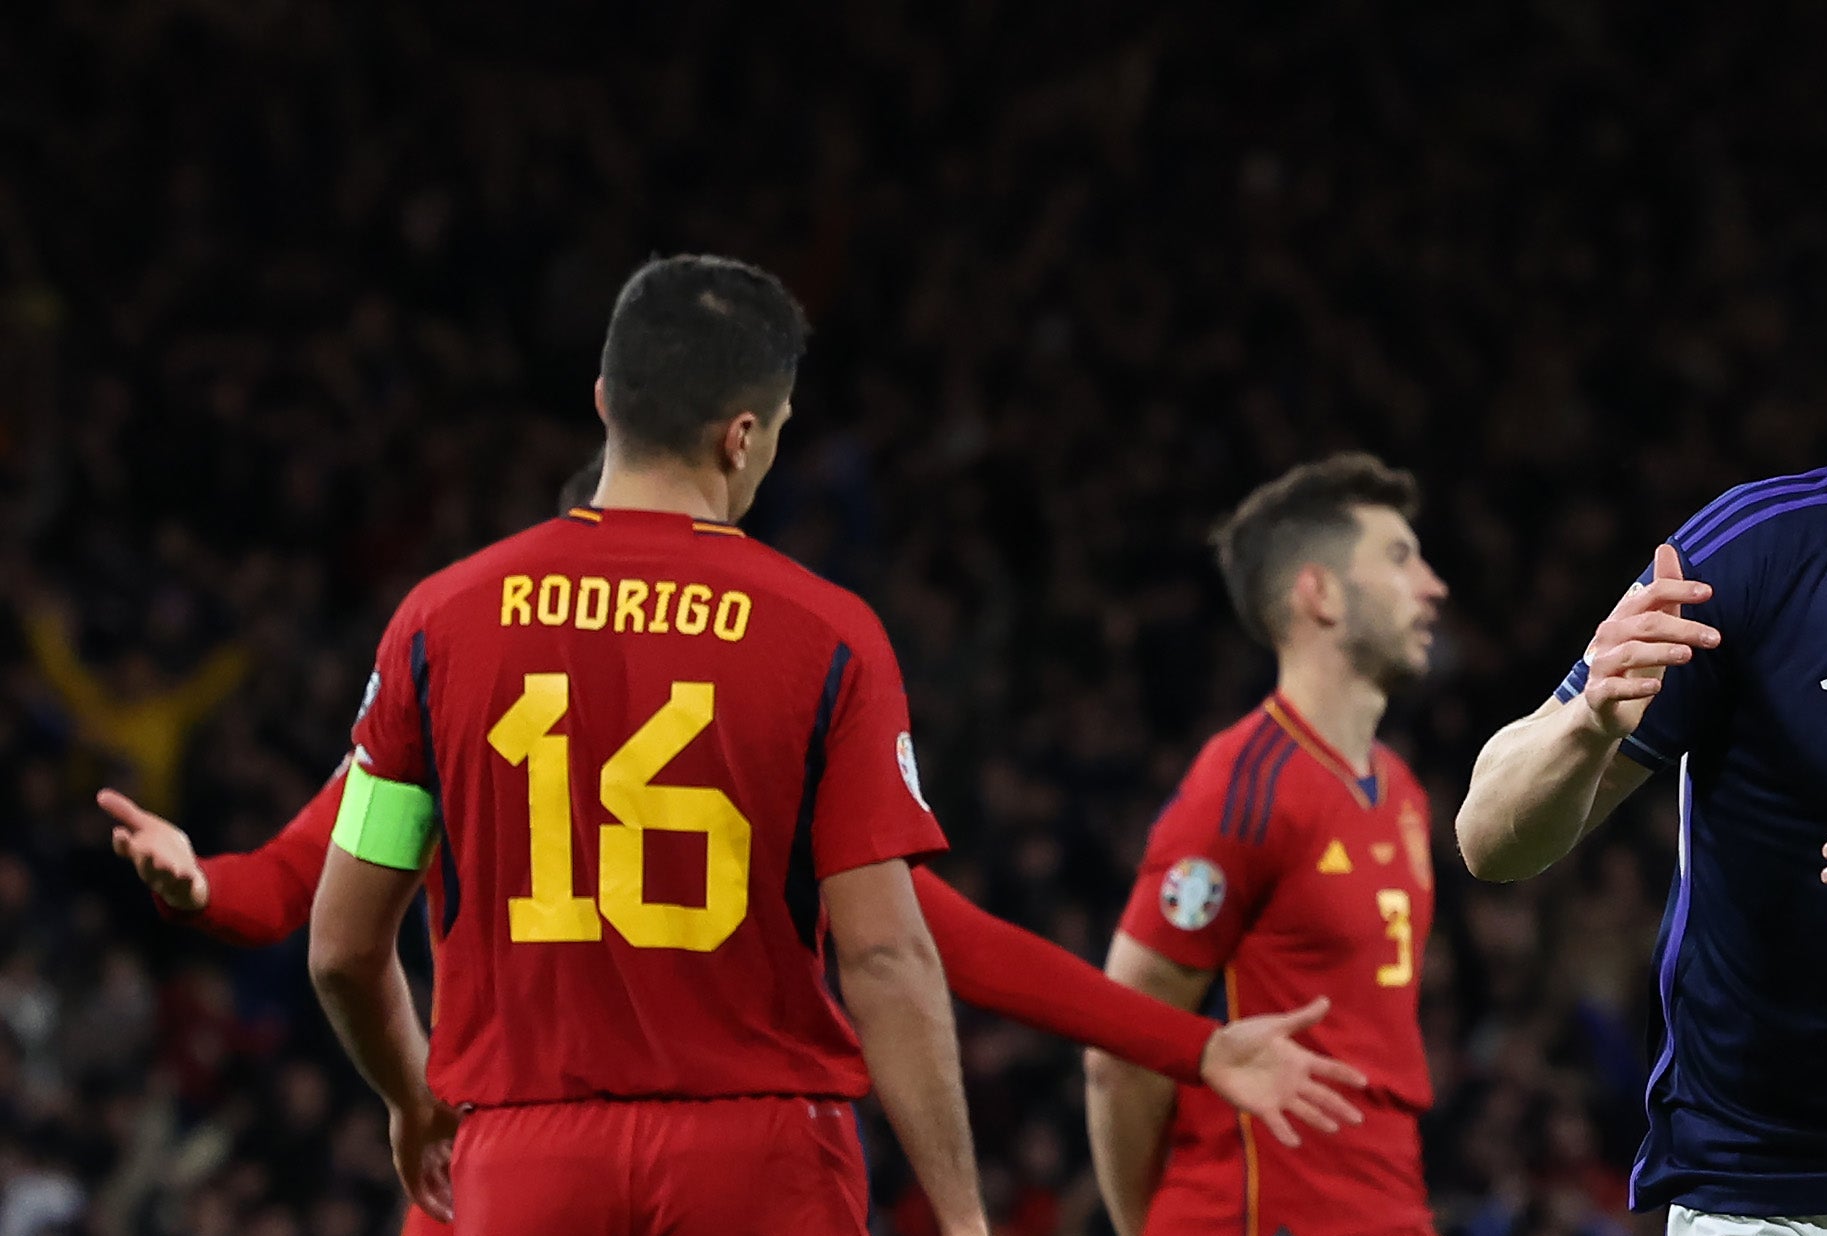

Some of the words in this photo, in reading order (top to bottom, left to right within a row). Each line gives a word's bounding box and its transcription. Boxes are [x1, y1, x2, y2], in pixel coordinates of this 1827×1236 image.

[500, 575, 752, 642] RODRIGO
[486, 673, 752, 951] 16
[1375, 888, 1414, 987] 3
